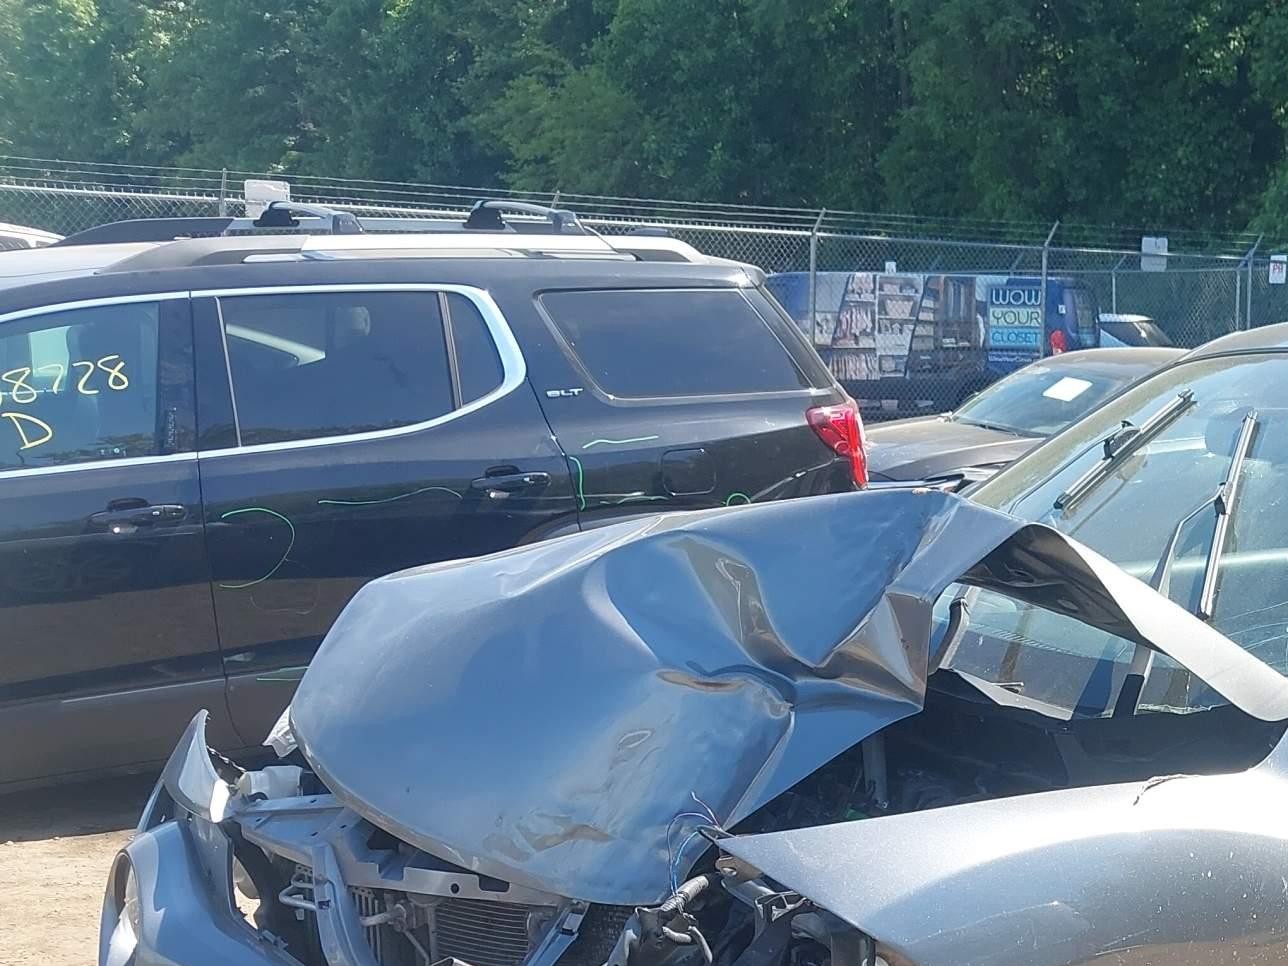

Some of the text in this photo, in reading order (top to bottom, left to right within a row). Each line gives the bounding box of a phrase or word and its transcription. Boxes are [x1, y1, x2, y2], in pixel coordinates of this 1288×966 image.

[992, 288, 1041, 305] WOW
[992, 310, 1041, 326] YOUR
[992, 331, 1038, 344] CLOSET
[0, 354, 129, 404] 8728
[1, 412, 53, 450] D
